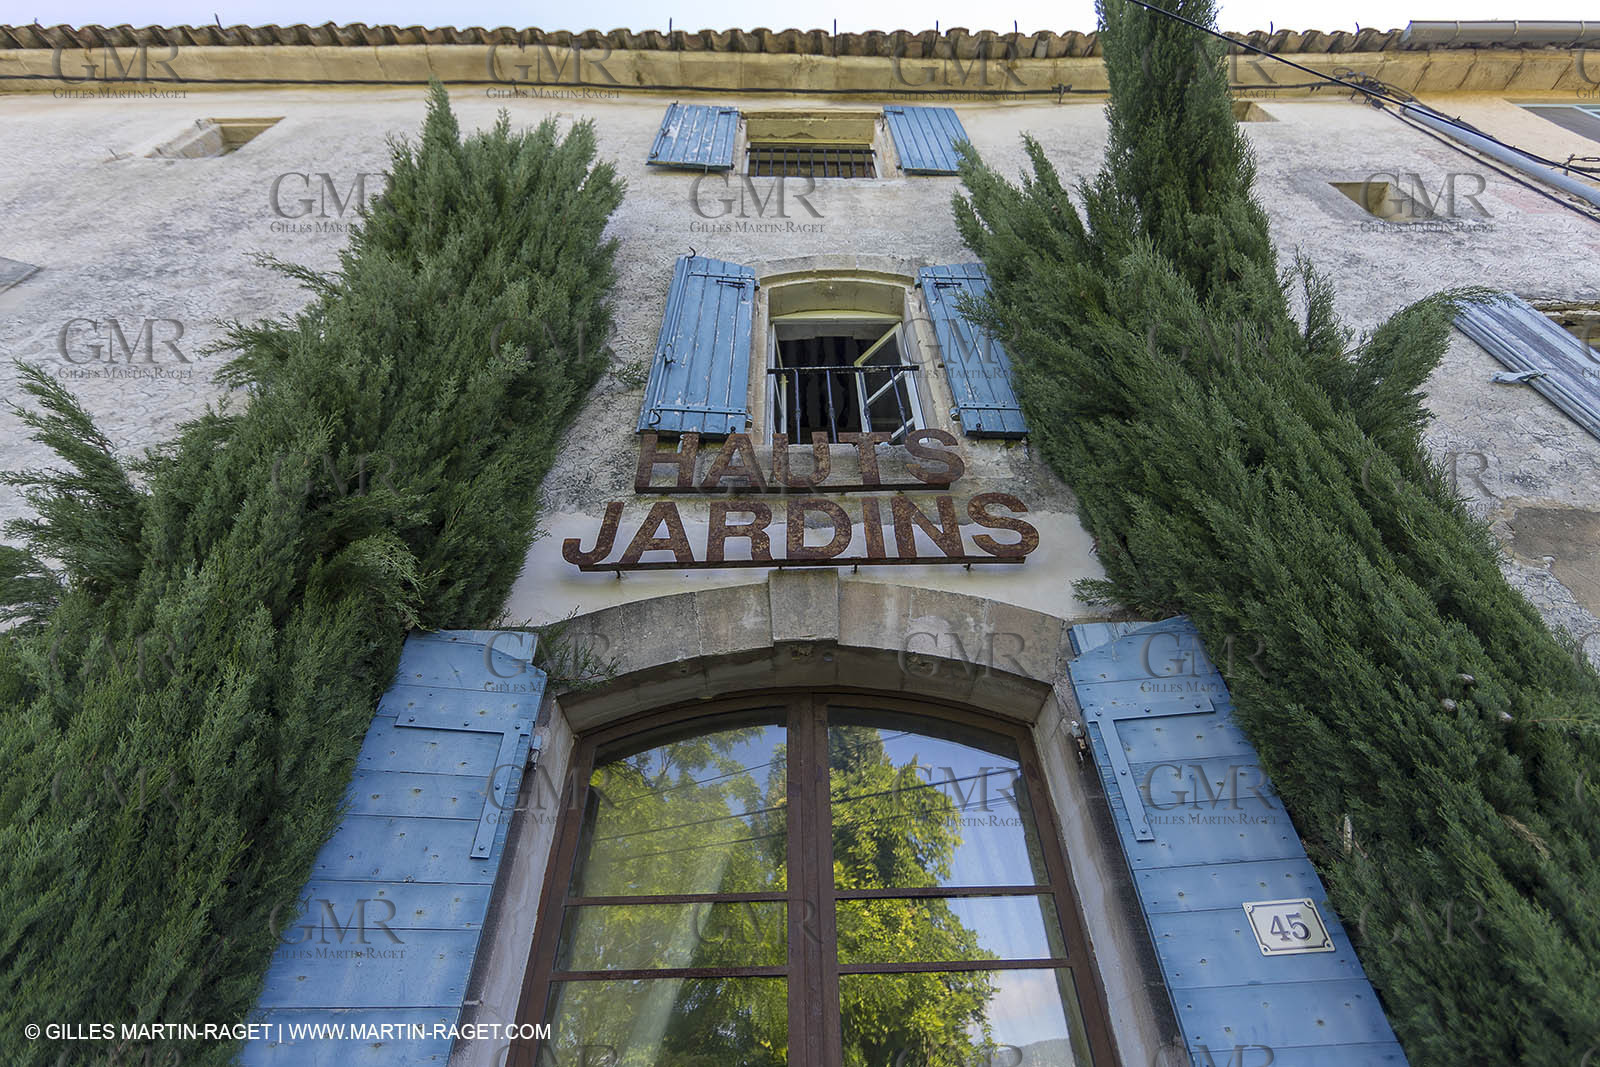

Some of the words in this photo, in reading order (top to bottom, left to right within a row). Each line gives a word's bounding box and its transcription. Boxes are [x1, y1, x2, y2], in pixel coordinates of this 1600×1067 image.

[635, 428, 965, 487] HAUTS
[562, 492, 1040, 566] JARDINS
[1270, 912, 1311, 941] 45
